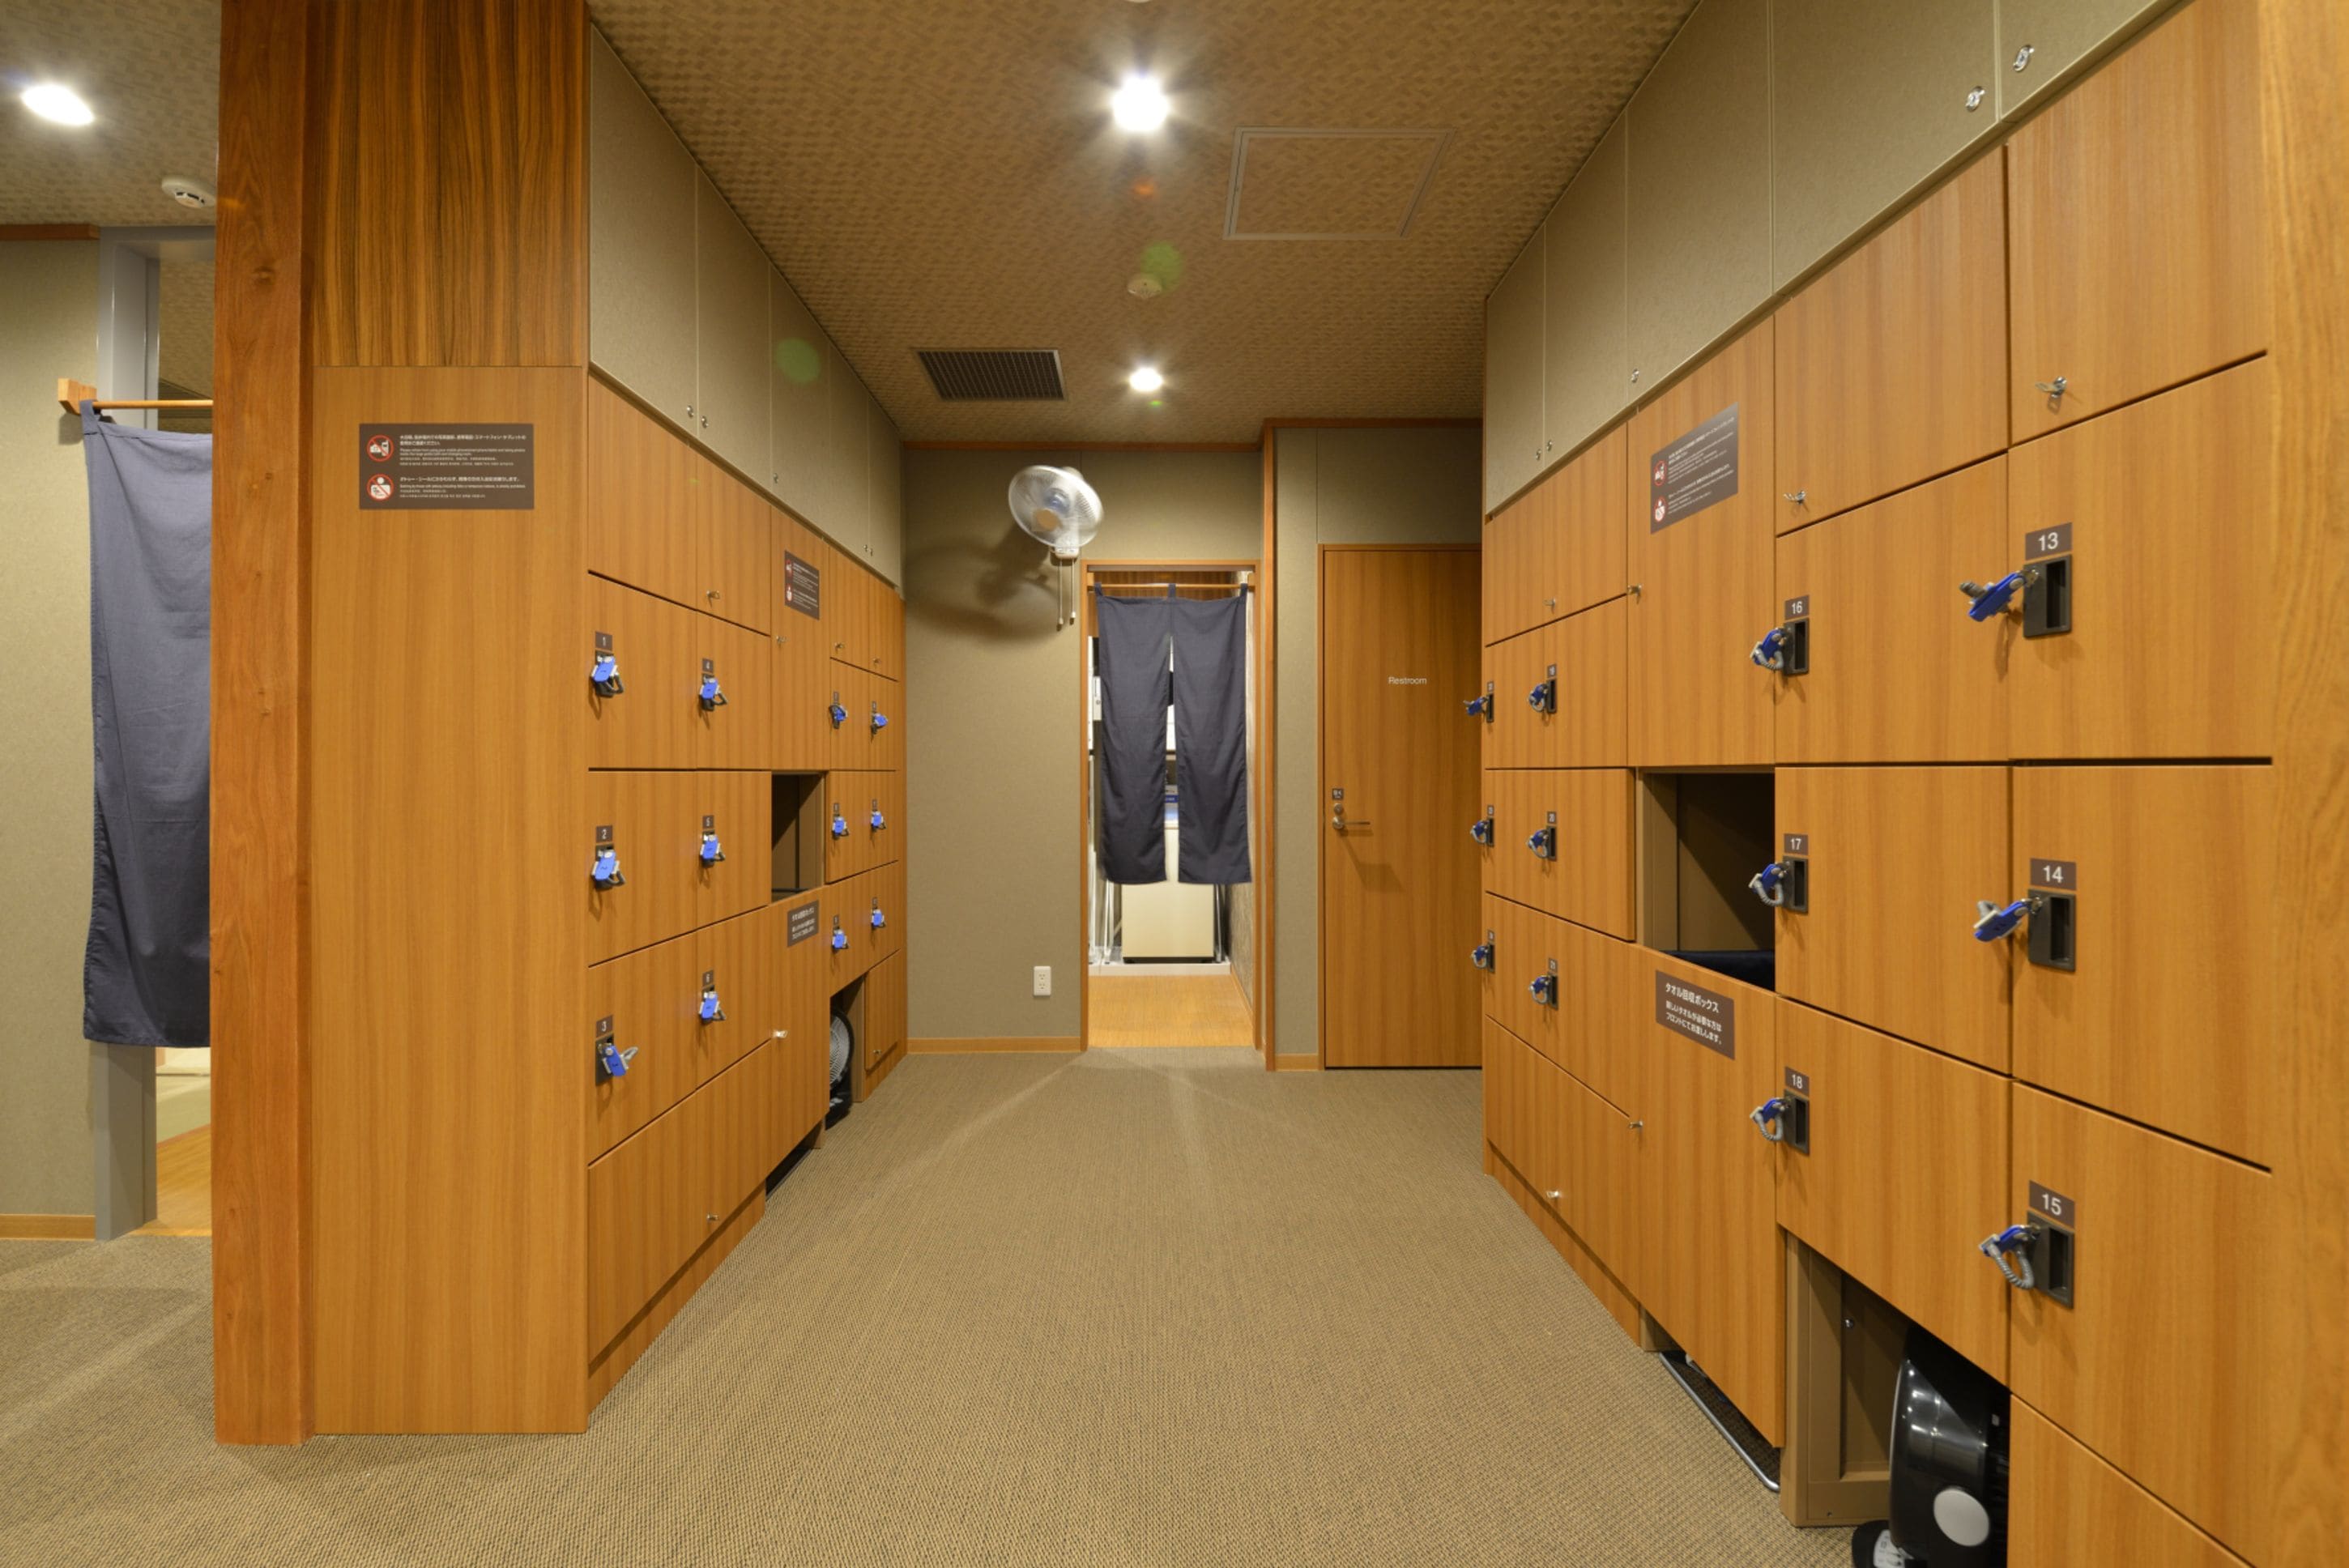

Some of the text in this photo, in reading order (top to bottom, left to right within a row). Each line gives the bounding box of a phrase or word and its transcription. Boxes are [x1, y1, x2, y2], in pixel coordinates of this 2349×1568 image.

[2038, 532, 2058, 552] 13
[1792, 601, 1802, 615] 16
[1388, 676, 1427, 685] Restroom
[601, 829, 608, 840] 2
[1790, 837, 1801, 850] 17
[2043, 865, 2063, 884] 14
[1665, 982, 1719, 1013] タオル回収ボックス
[601, 1020, 607, 1032] 3
[1792, 1074, 1802, 1089] 18
[2042, 1193, 2061, 1216] 15
